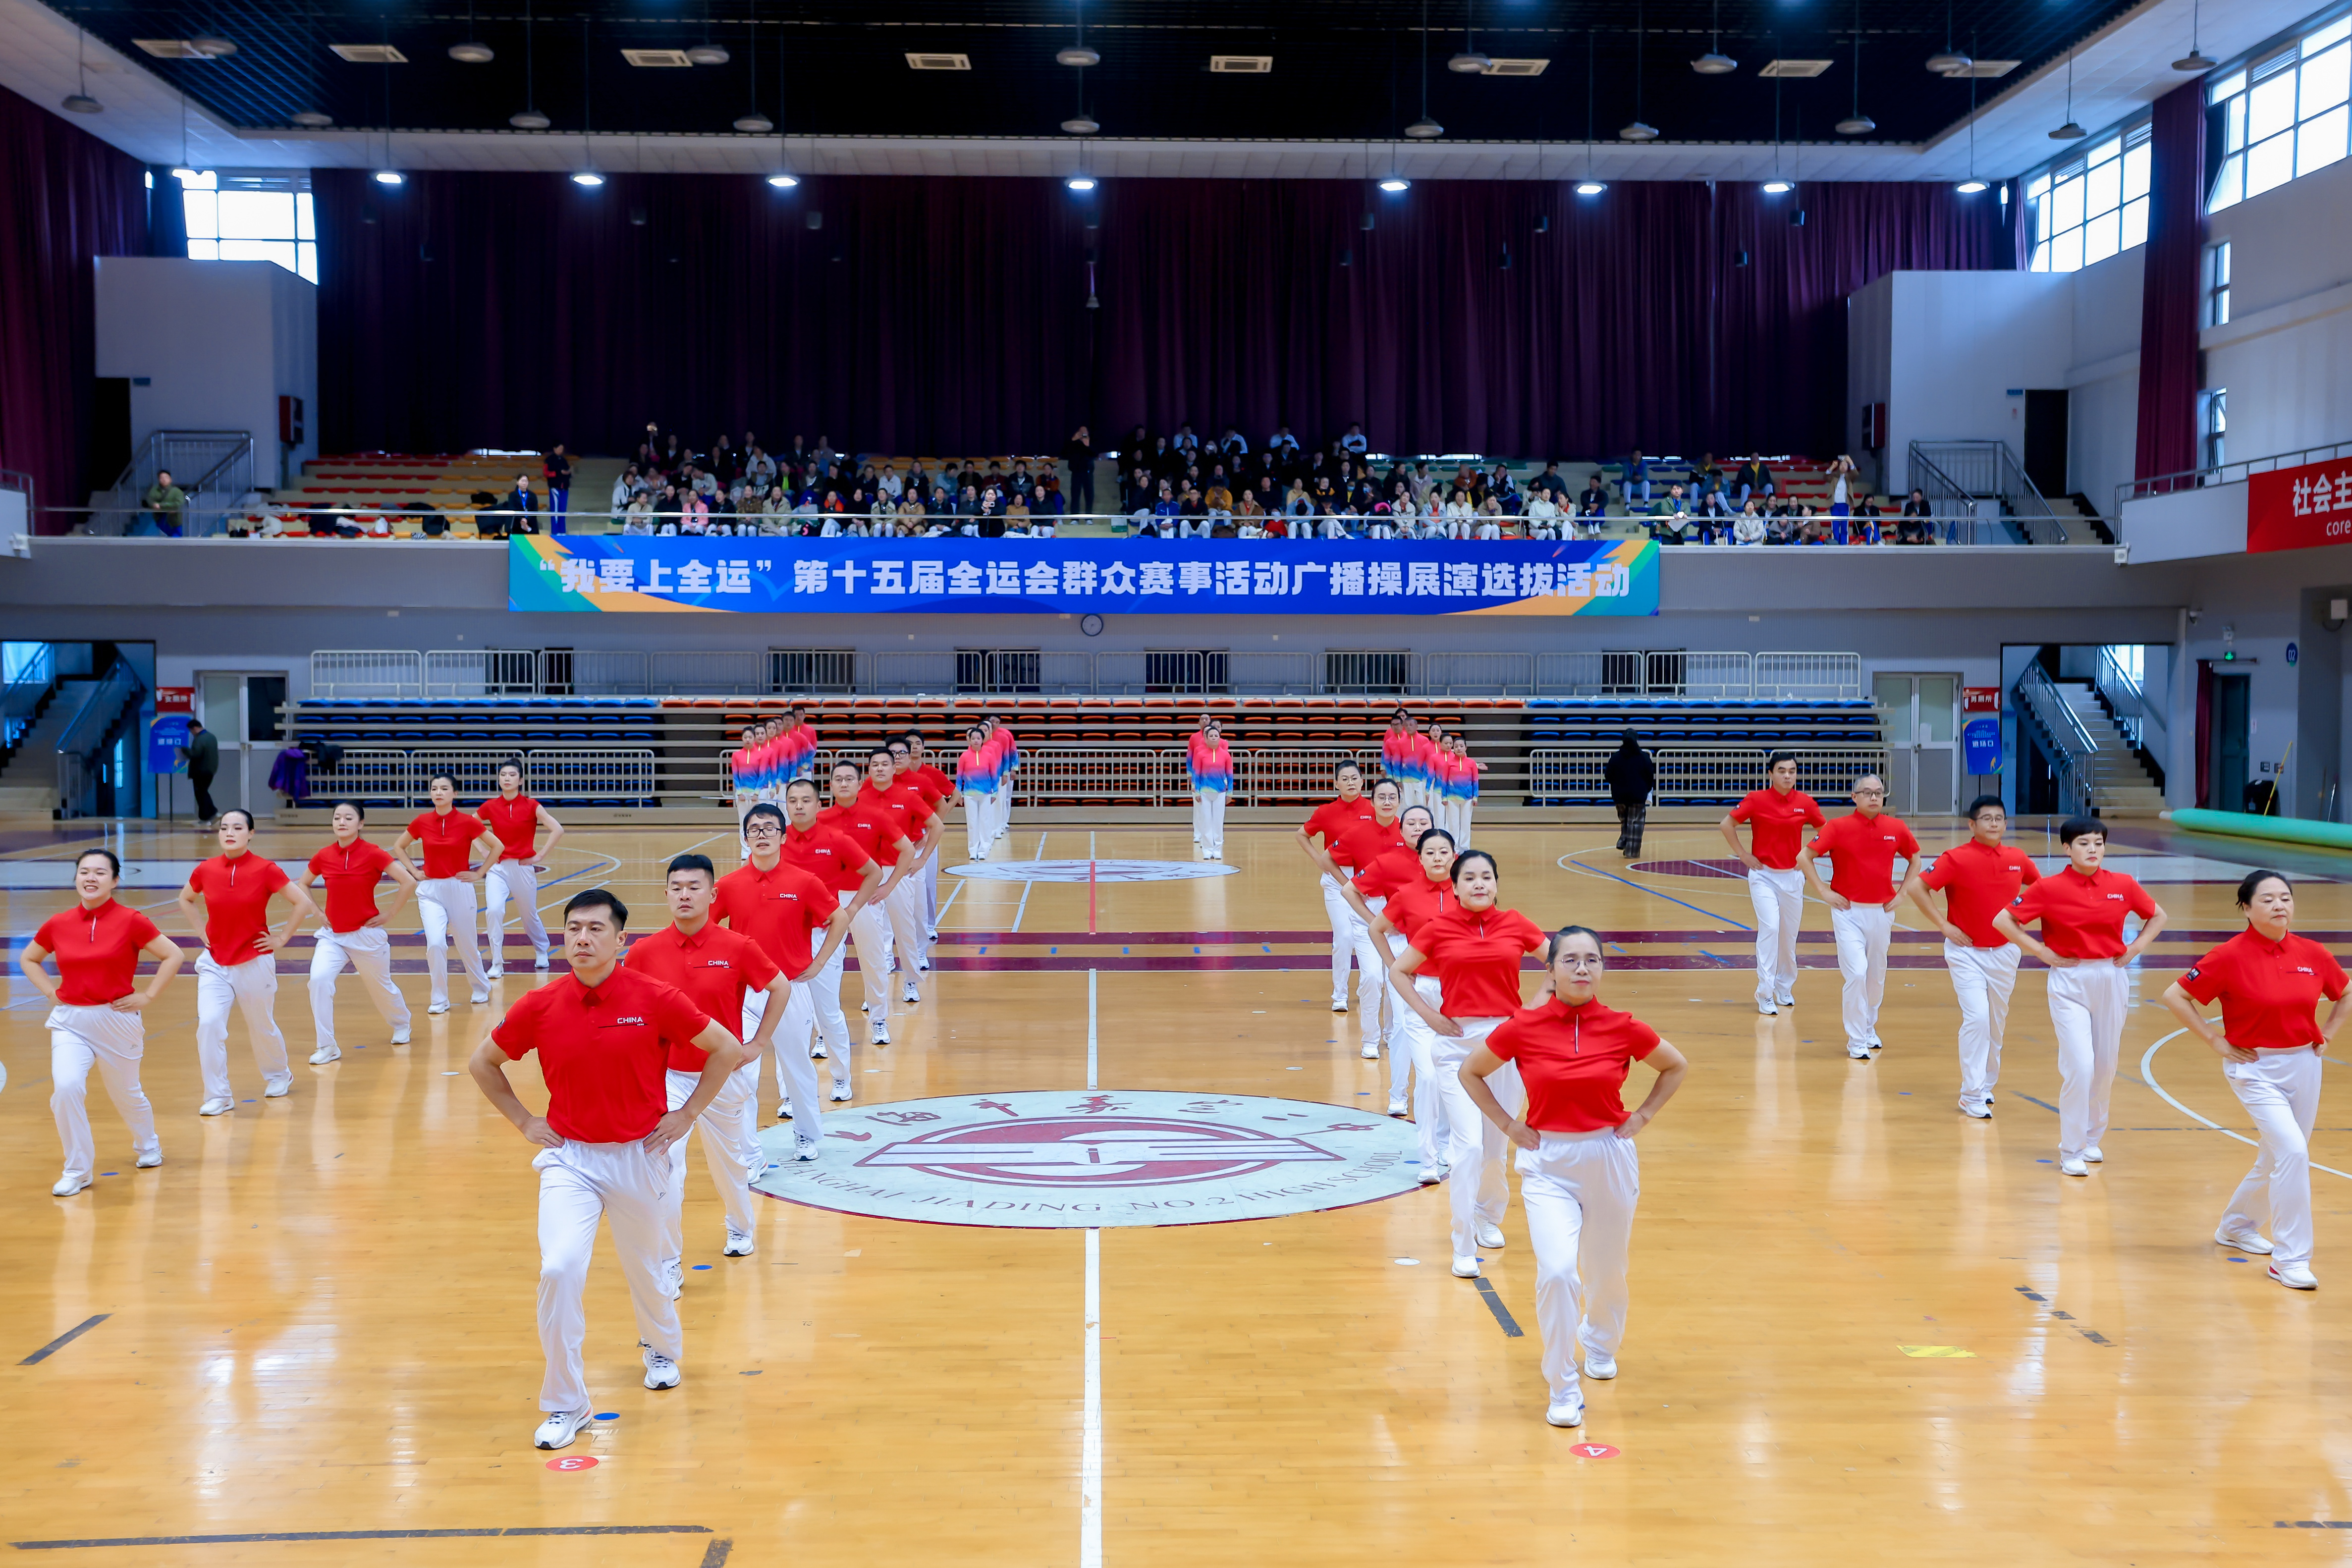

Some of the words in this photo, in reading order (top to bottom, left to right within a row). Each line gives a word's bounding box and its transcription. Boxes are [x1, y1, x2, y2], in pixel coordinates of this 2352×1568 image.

[2293, 471, 2352, 517] 社会主
[2326, 519, 2351, 536] core
[793, 559, 1630, 597] 第十五届全运会群众赛事活动广播操展演选拔活动
[2288, 649, 2296, 661] 02
[911, 1196, 1101, 1212] JIADING
[1236, 1182, 1338, 1201] HIGH
[1327, 1150, 1402, 1184] SCHOOL
[1583, 1445, 1608, 1457] 4
[559, 1458, 584, 1469] 3
